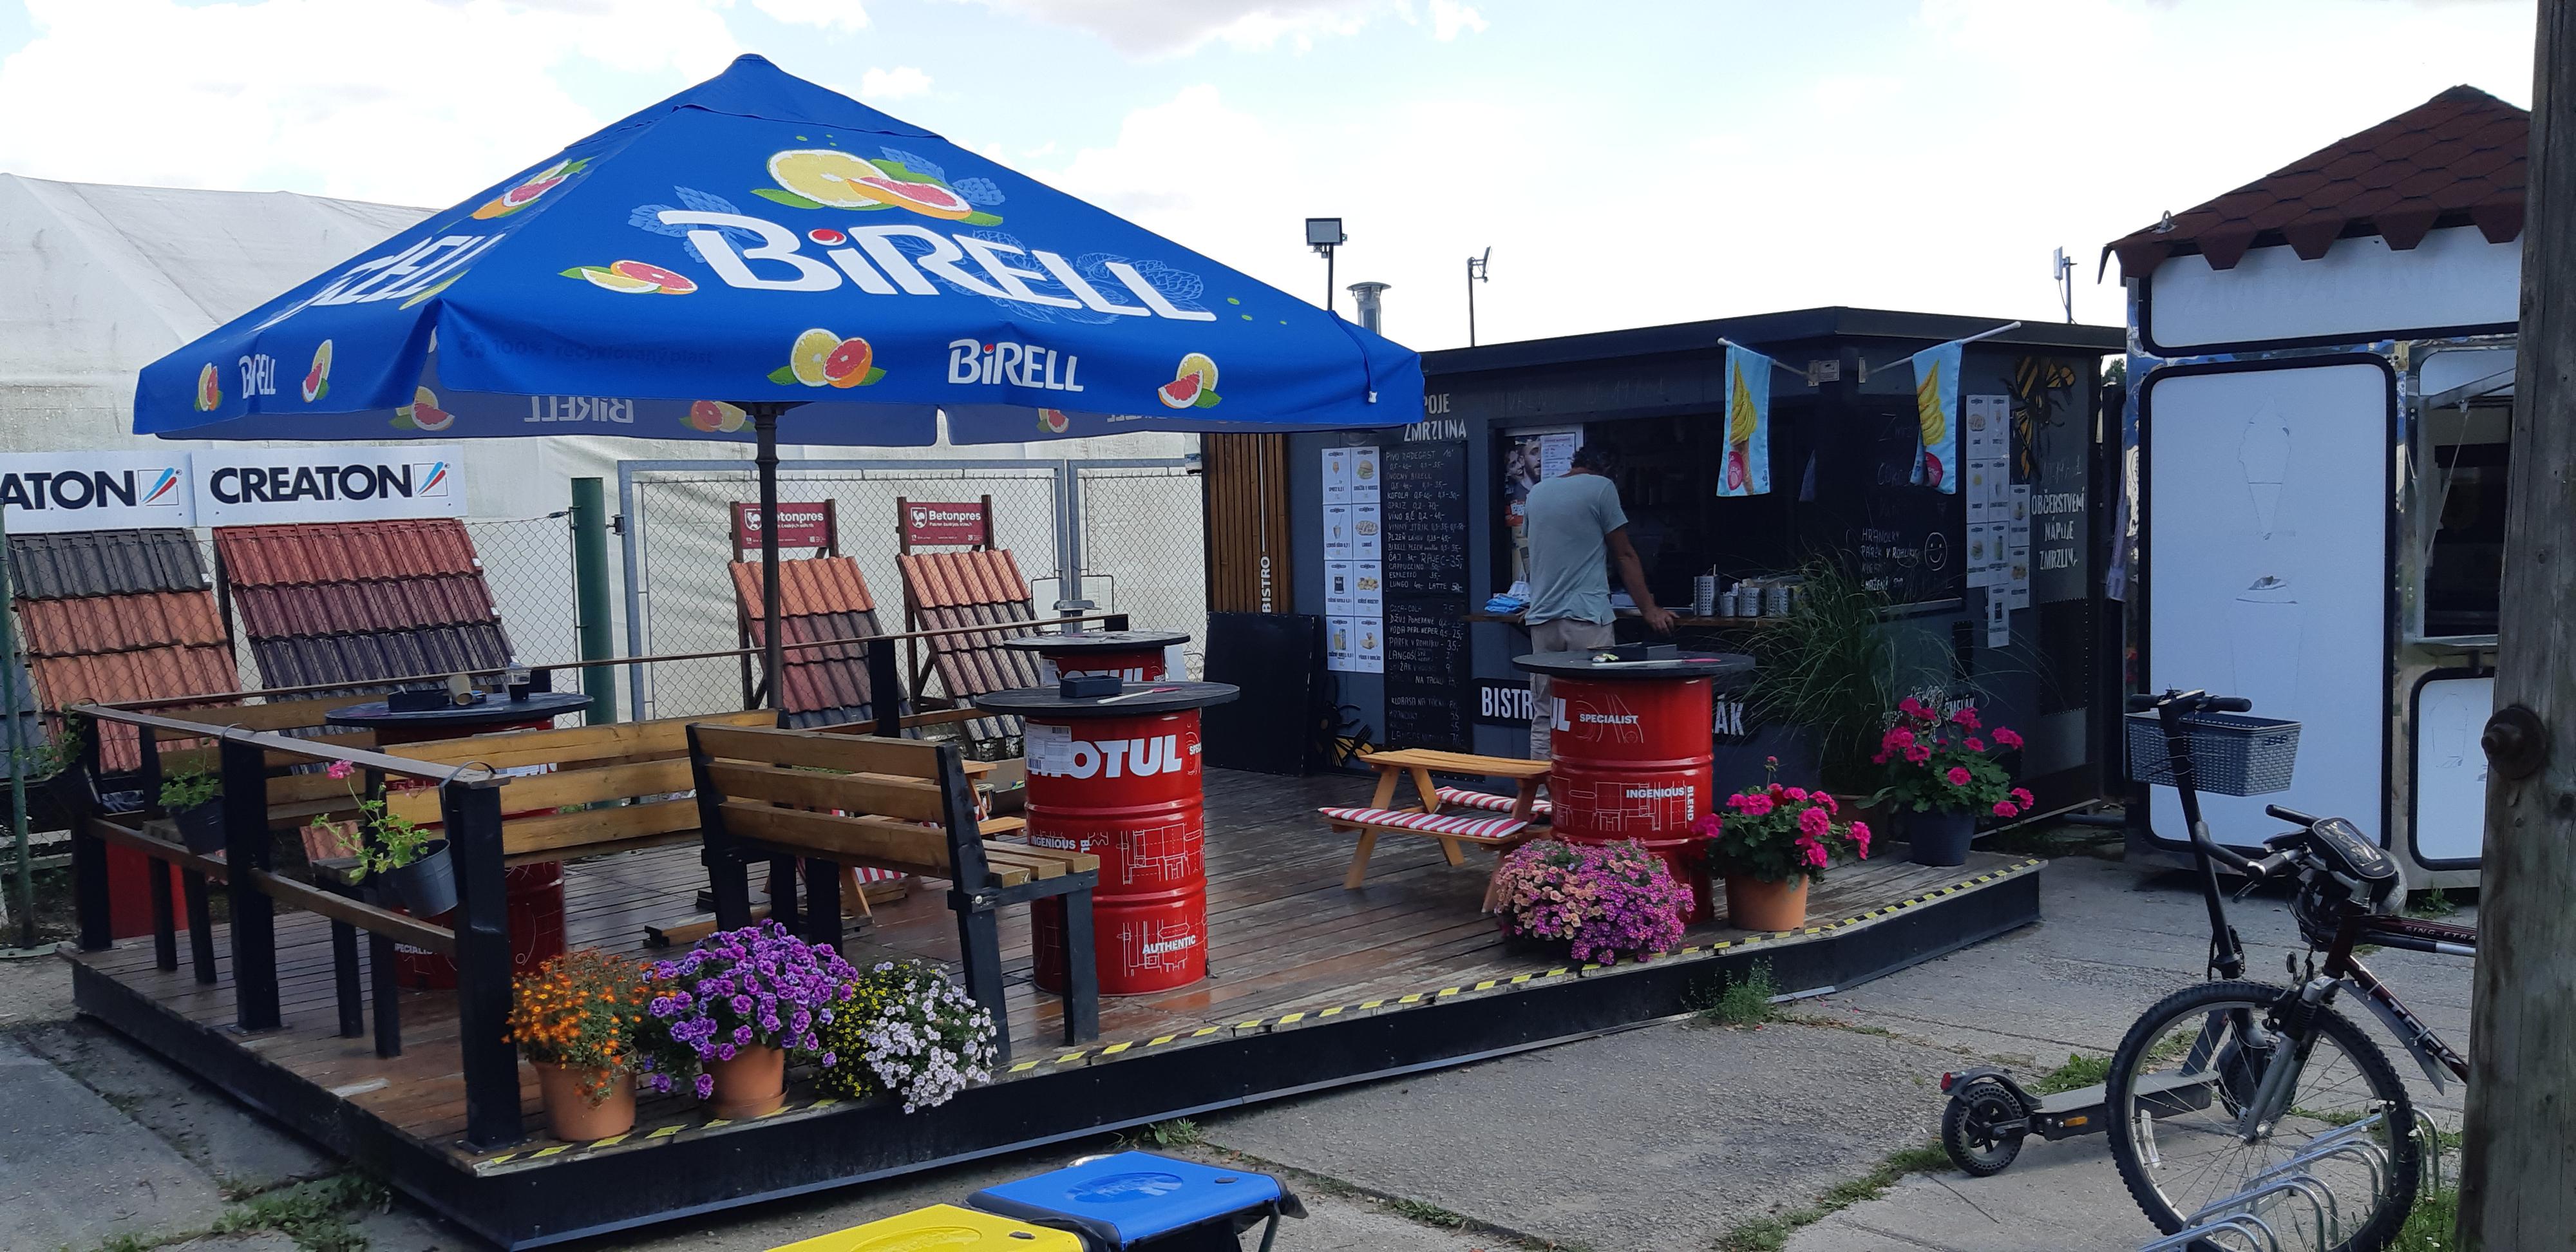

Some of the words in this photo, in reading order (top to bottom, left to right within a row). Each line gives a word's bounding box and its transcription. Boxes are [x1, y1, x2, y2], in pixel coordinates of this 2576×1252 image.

[1386, 452, 1399, 461] PIVO
[0, 470, 137, 510] ATON
[210, 464, 413, 504] CREATON
[2031, 486, 2085, 515] OBČERSTVENÍ
[929, 511, 981, 522] Betonpres
[1388, 511, 1402, 520] VÍNO
[1388, 533, 1405, 541] PLZEŇ
[1862, 527, 1899, 543] HRANOLKY
[1388, 552, 1401, 561] ČAJ
[1260, 556, 1271, 612] BISTRO
[1390, 614, 1405, 623] DŽUS
[1390, 626, 1405, 634] VODA
[1416, 676, 1424, 684] NA
[1580, 714, 1638, 724] SPECIALIST
[1712, 694, 1745, 736] ÁK
[1030, 734, 1182, 779] OTUL
[1626, 788, 1685, 799] INGENIOUS
[1031, 835, 1076, 849] INGENIOUS
[1142, 934, 1195, 954] AUTHENTIC
[2389, 998, 2462, 1066] TREK
